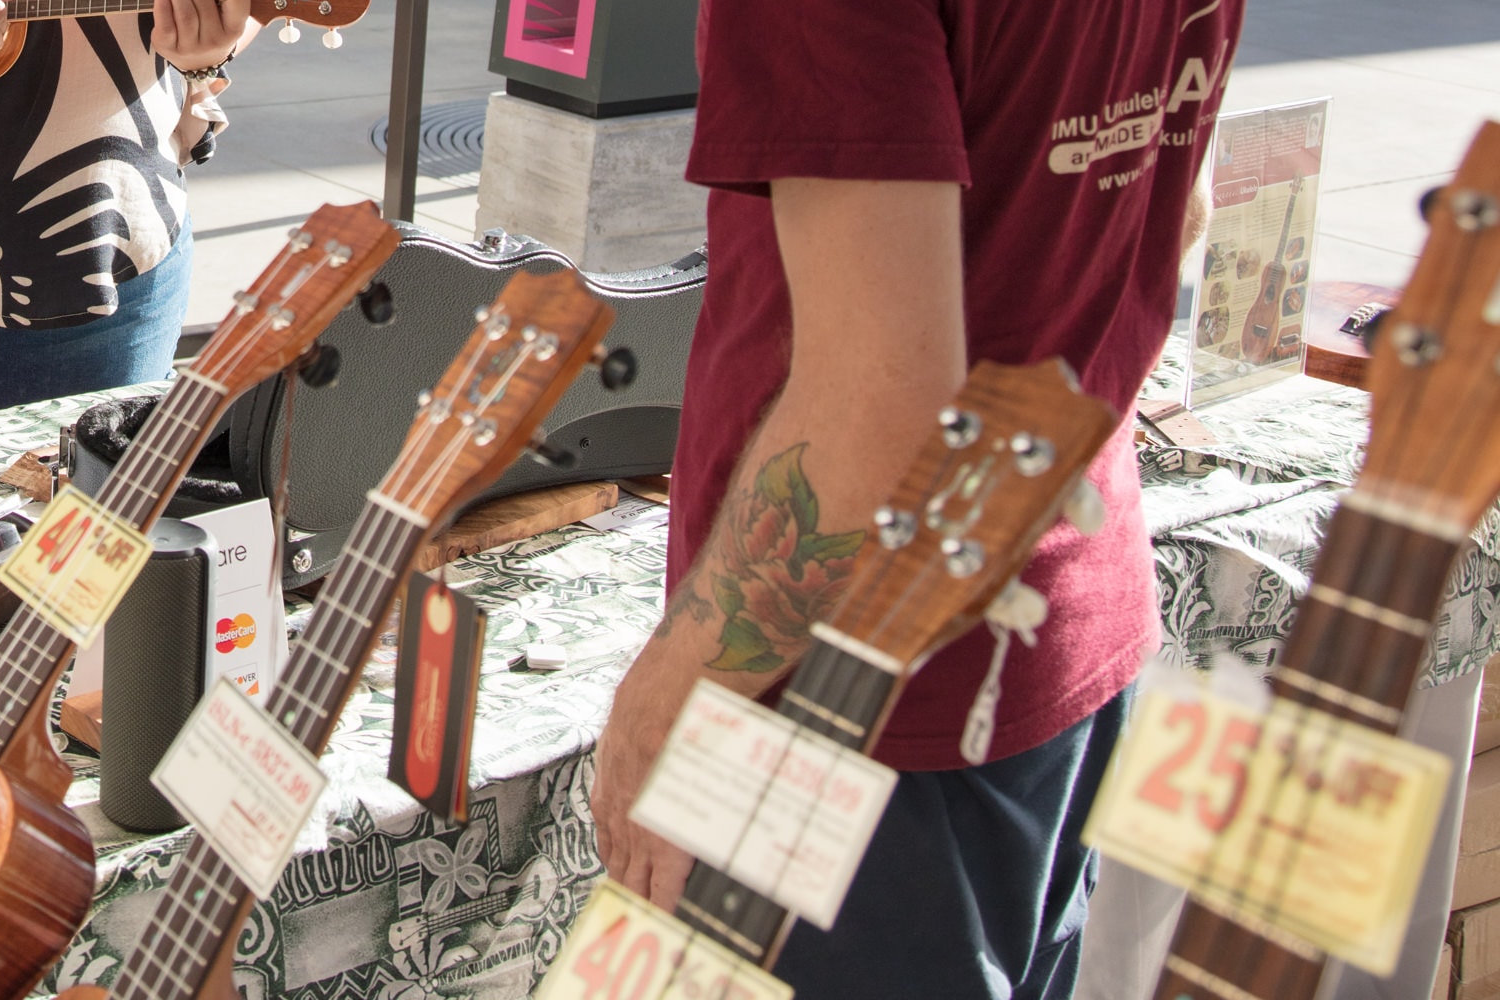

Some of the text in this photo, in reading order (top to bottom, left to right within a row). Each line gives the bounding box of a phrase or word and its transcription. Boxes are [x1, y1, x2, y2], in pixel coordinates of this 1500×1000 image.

[1095, 123, 1144, 152] MADE
[37, 507, 93, 575] 40
[218, 545, 247, 567] are
[235, 673, 256, 685] OVER
[1138, 703, 1263, 834] 25
[573, 915, 661, 1000] 40
